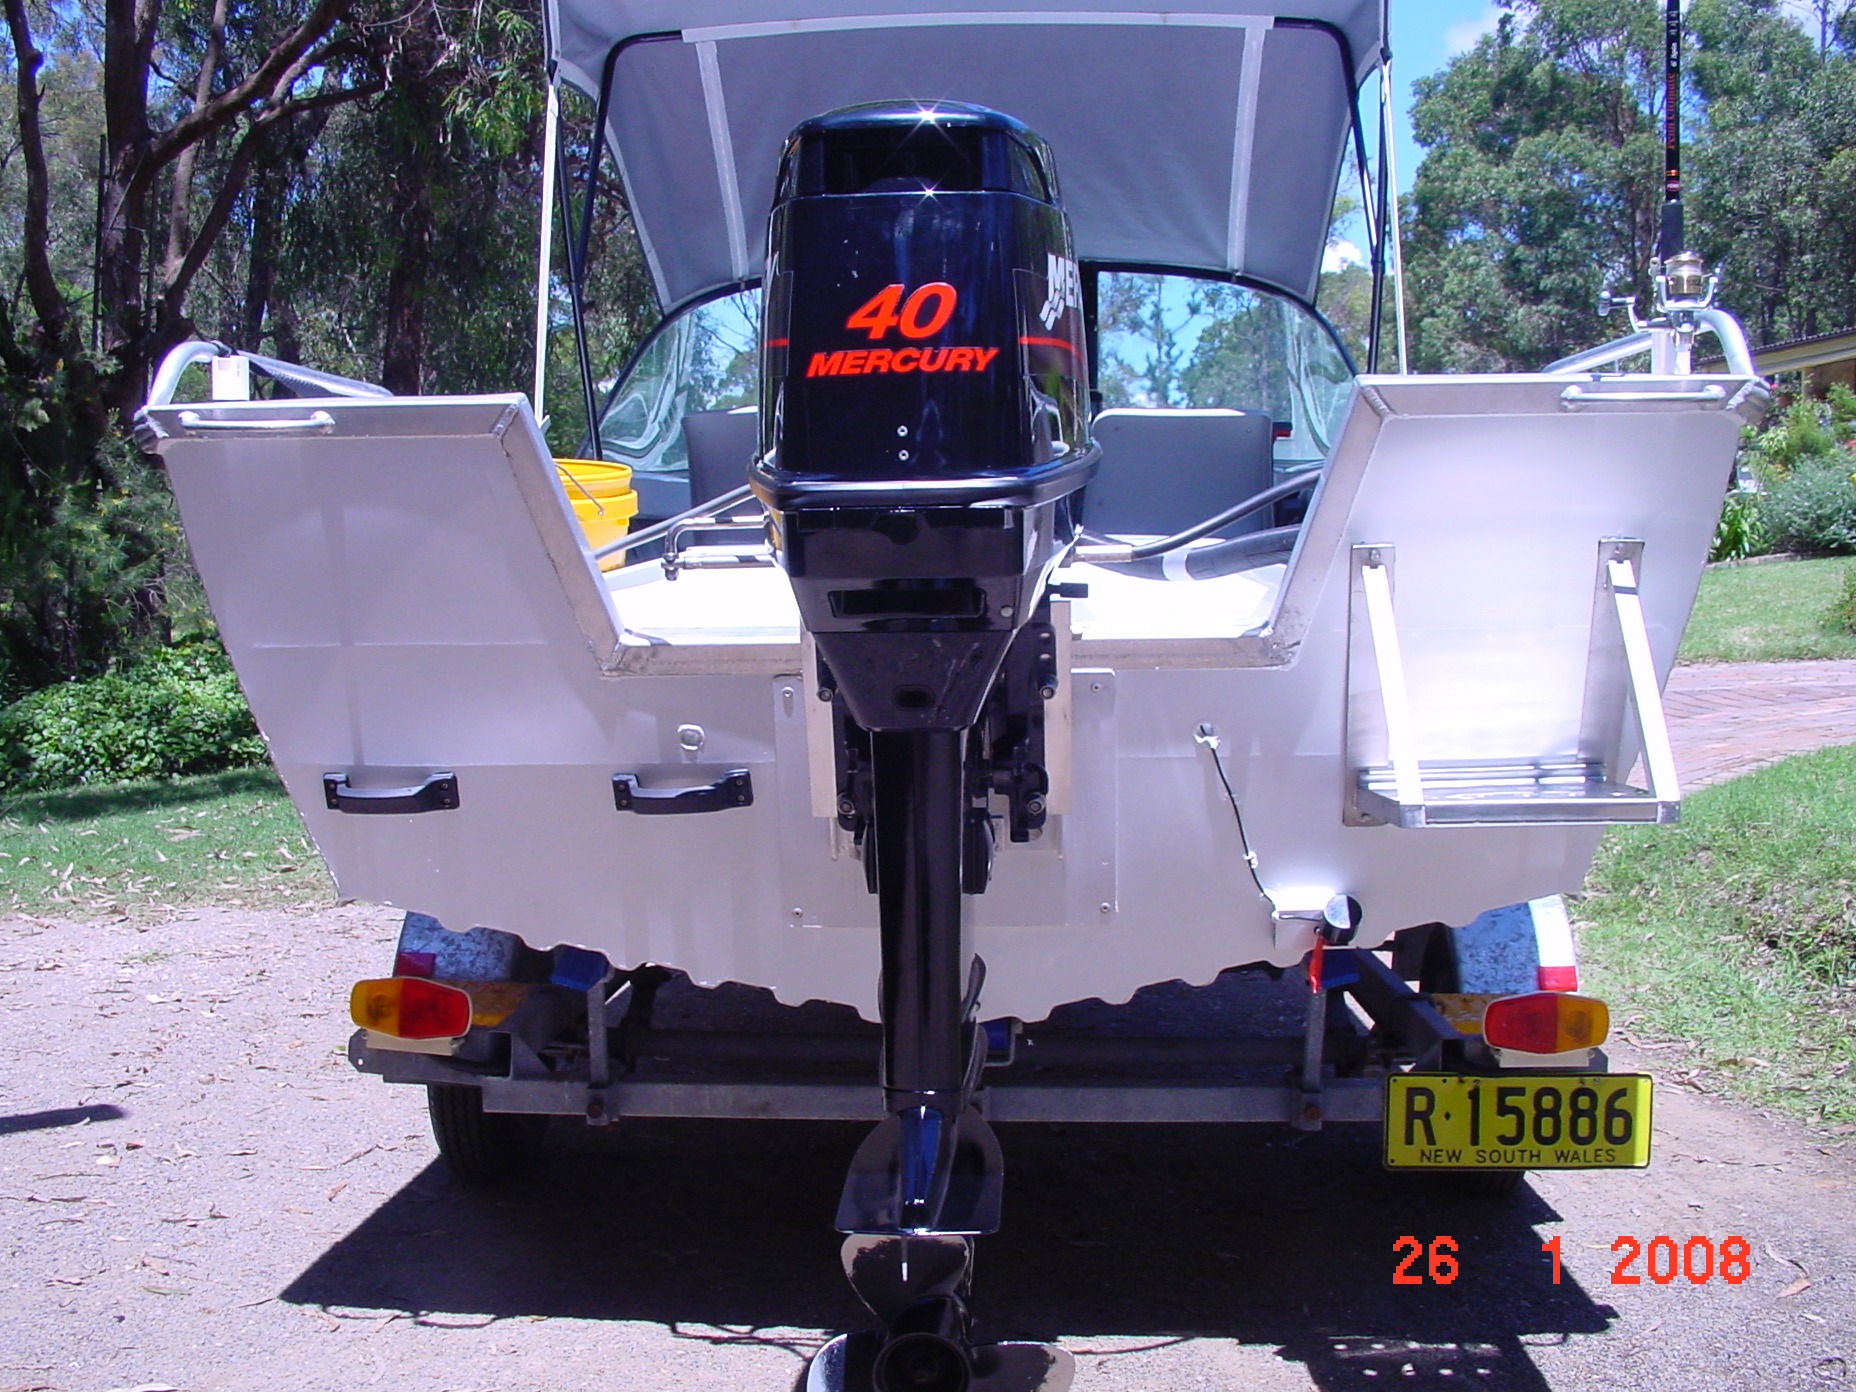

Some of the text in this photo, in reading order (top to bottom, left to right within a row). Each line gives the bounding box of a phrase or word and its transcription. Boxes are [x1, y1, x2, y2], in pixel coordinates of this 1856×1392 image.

[846, 283, 957, 340] 40
[806, 347, 1000, 378] MERCURY
[1420, 1149, 1616, 1163] NEW SOUTH WALES
